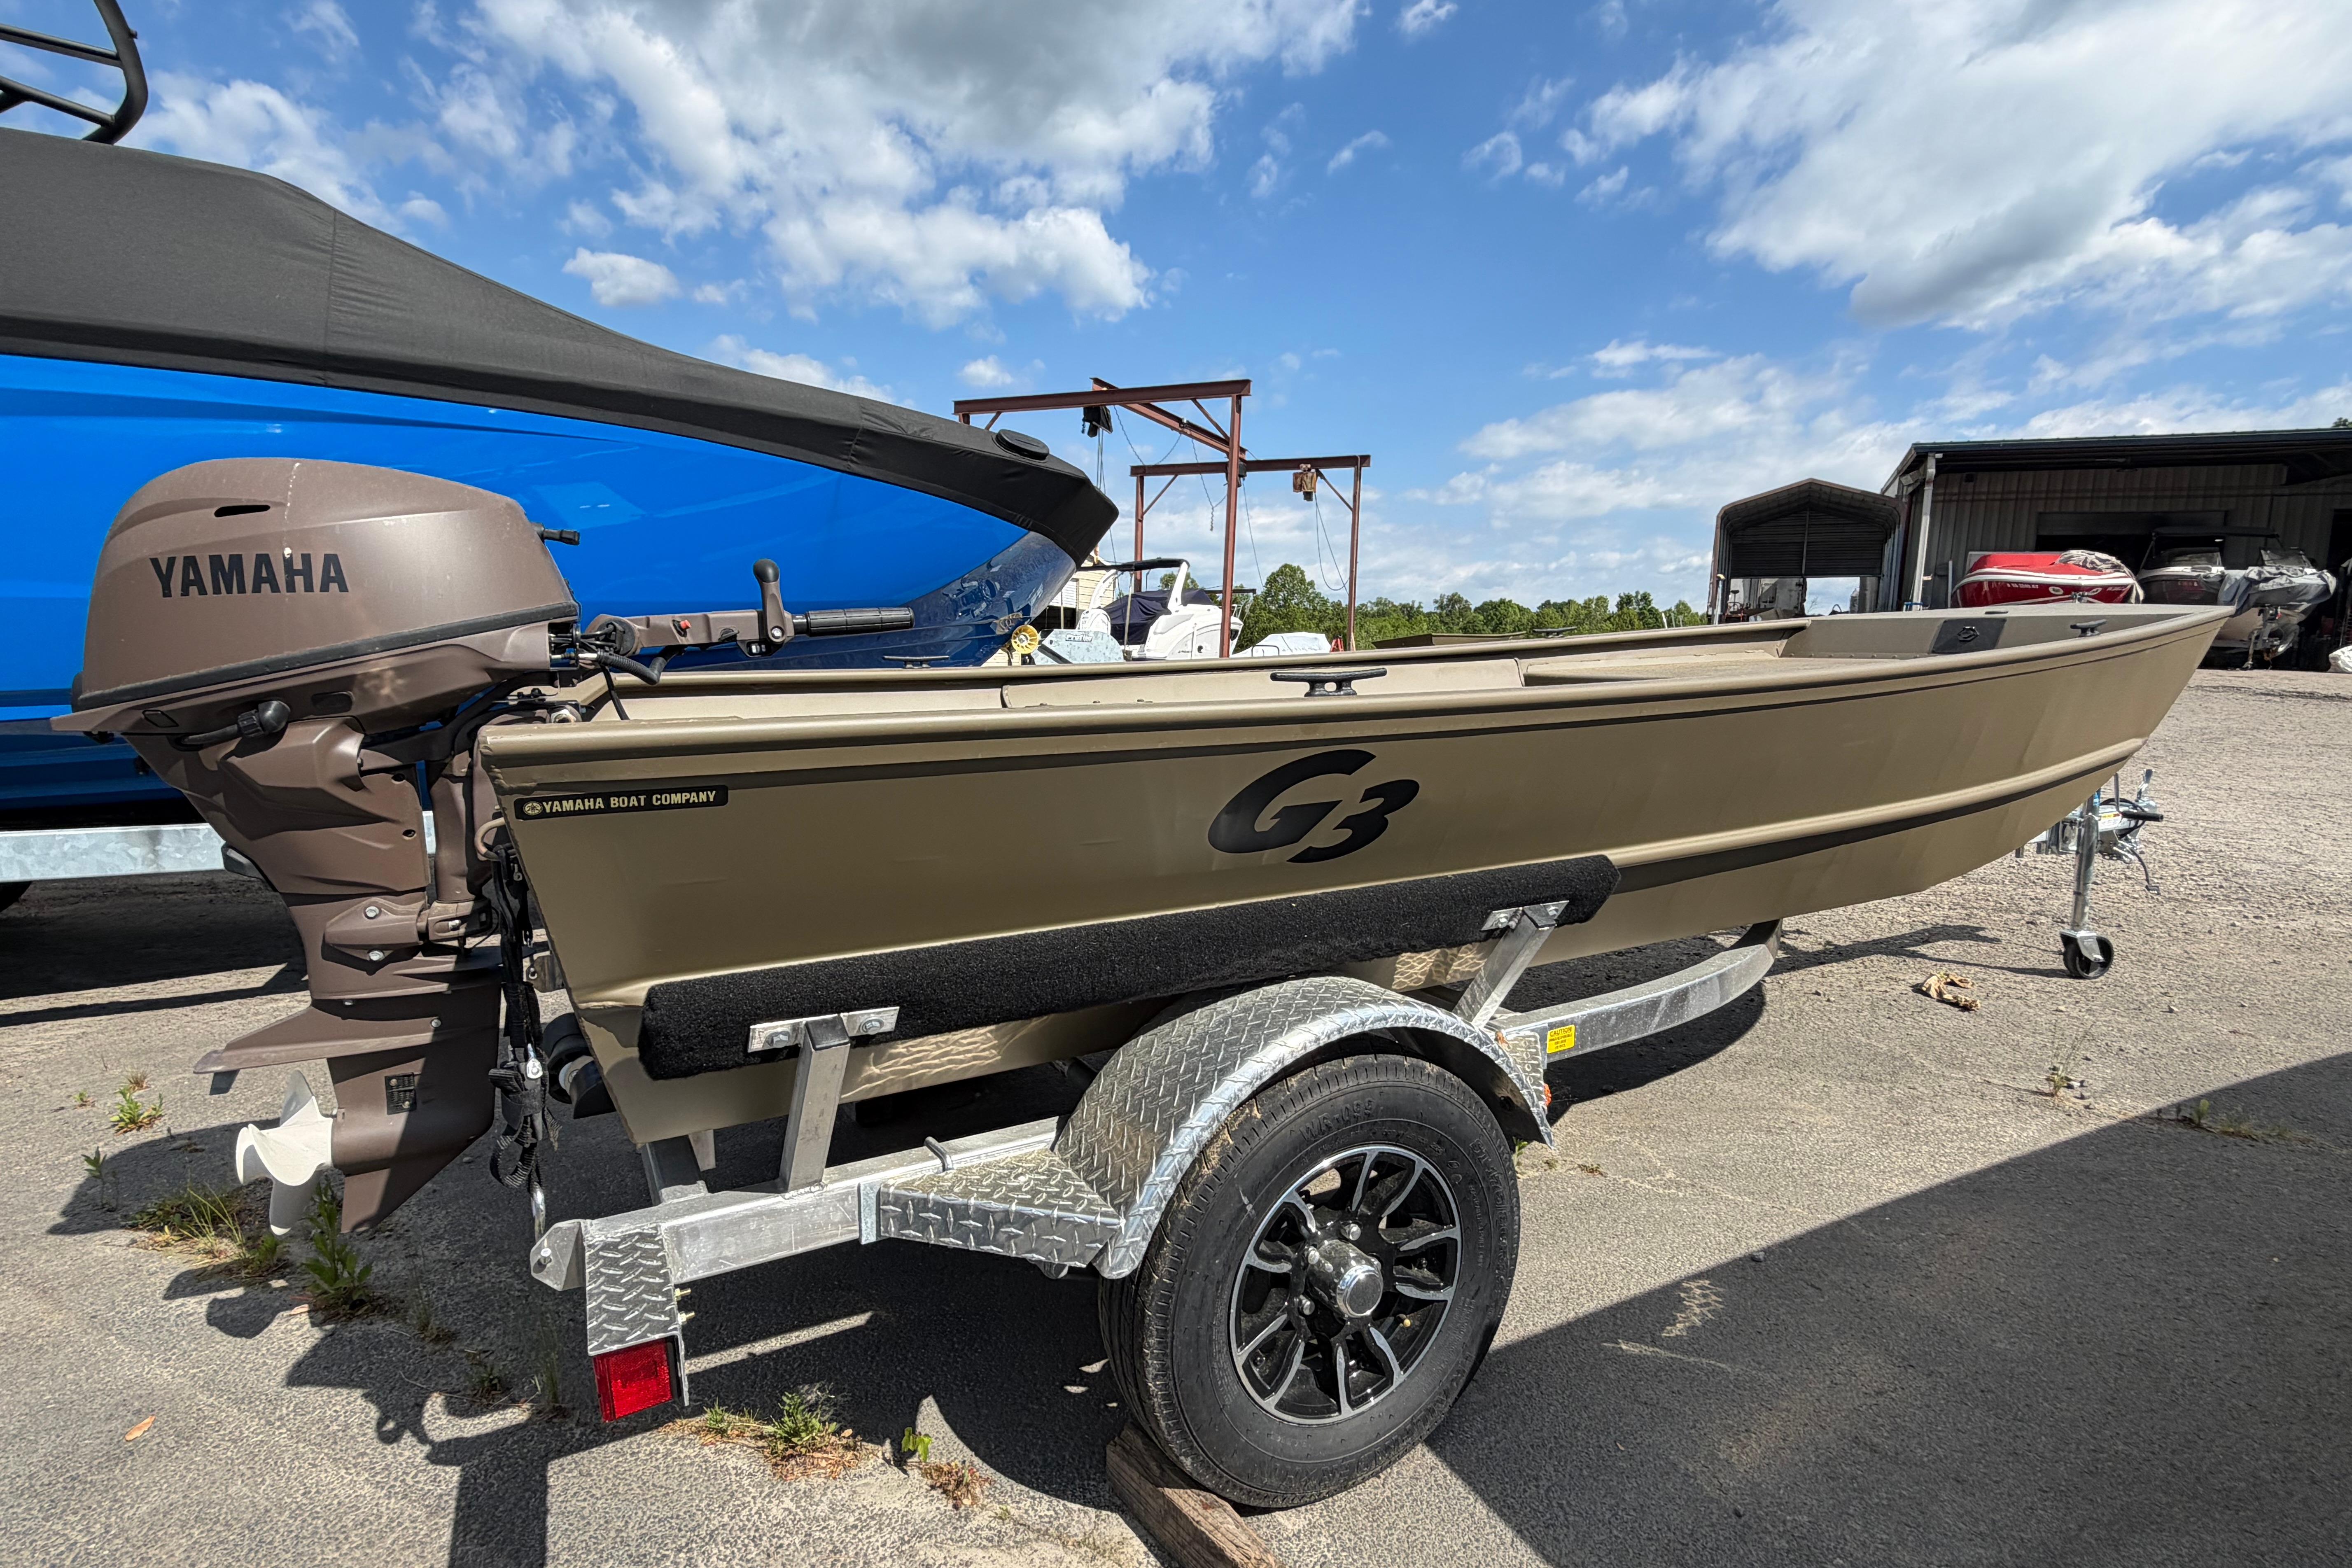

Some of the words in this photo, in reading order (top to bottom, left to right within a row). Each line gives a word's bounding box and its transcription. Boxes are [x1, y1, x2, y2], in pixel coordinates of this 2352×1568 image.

[149, 553, 349, 598] YAMAHA
[542, 797, 604, 813] YAMAHA
[610, 795, 646, 808] BOAT
[652, 791, 716, 805] COMPANY
[1208, 749, 1420, 863] G3
